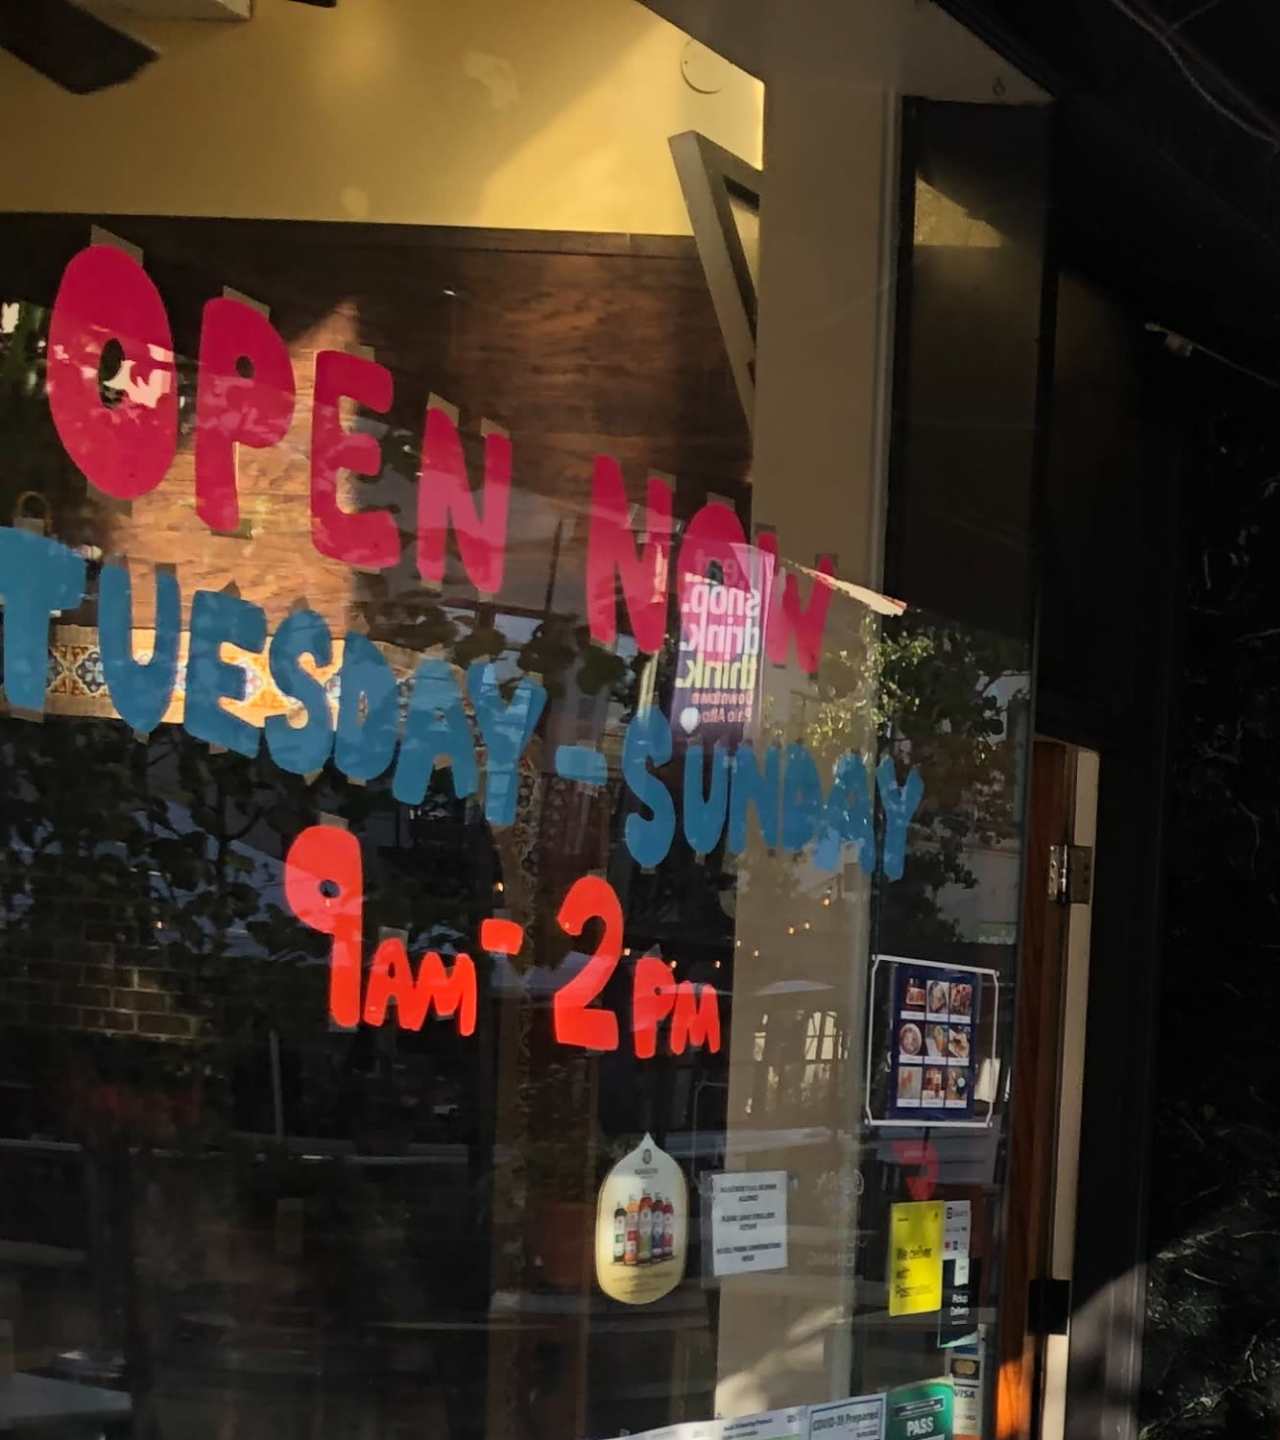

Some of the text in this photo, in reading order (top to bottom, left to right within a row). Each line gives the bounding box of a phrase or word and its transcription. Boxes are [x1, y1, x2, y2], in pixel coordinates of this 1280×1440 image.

[48, 243, 837, 674] OPEN NOW
[0, 524, 547, 827] TUESDAY
[624, 704, 925, 882] SUNDAY
[906, 1415, 934, 1438] PASS
